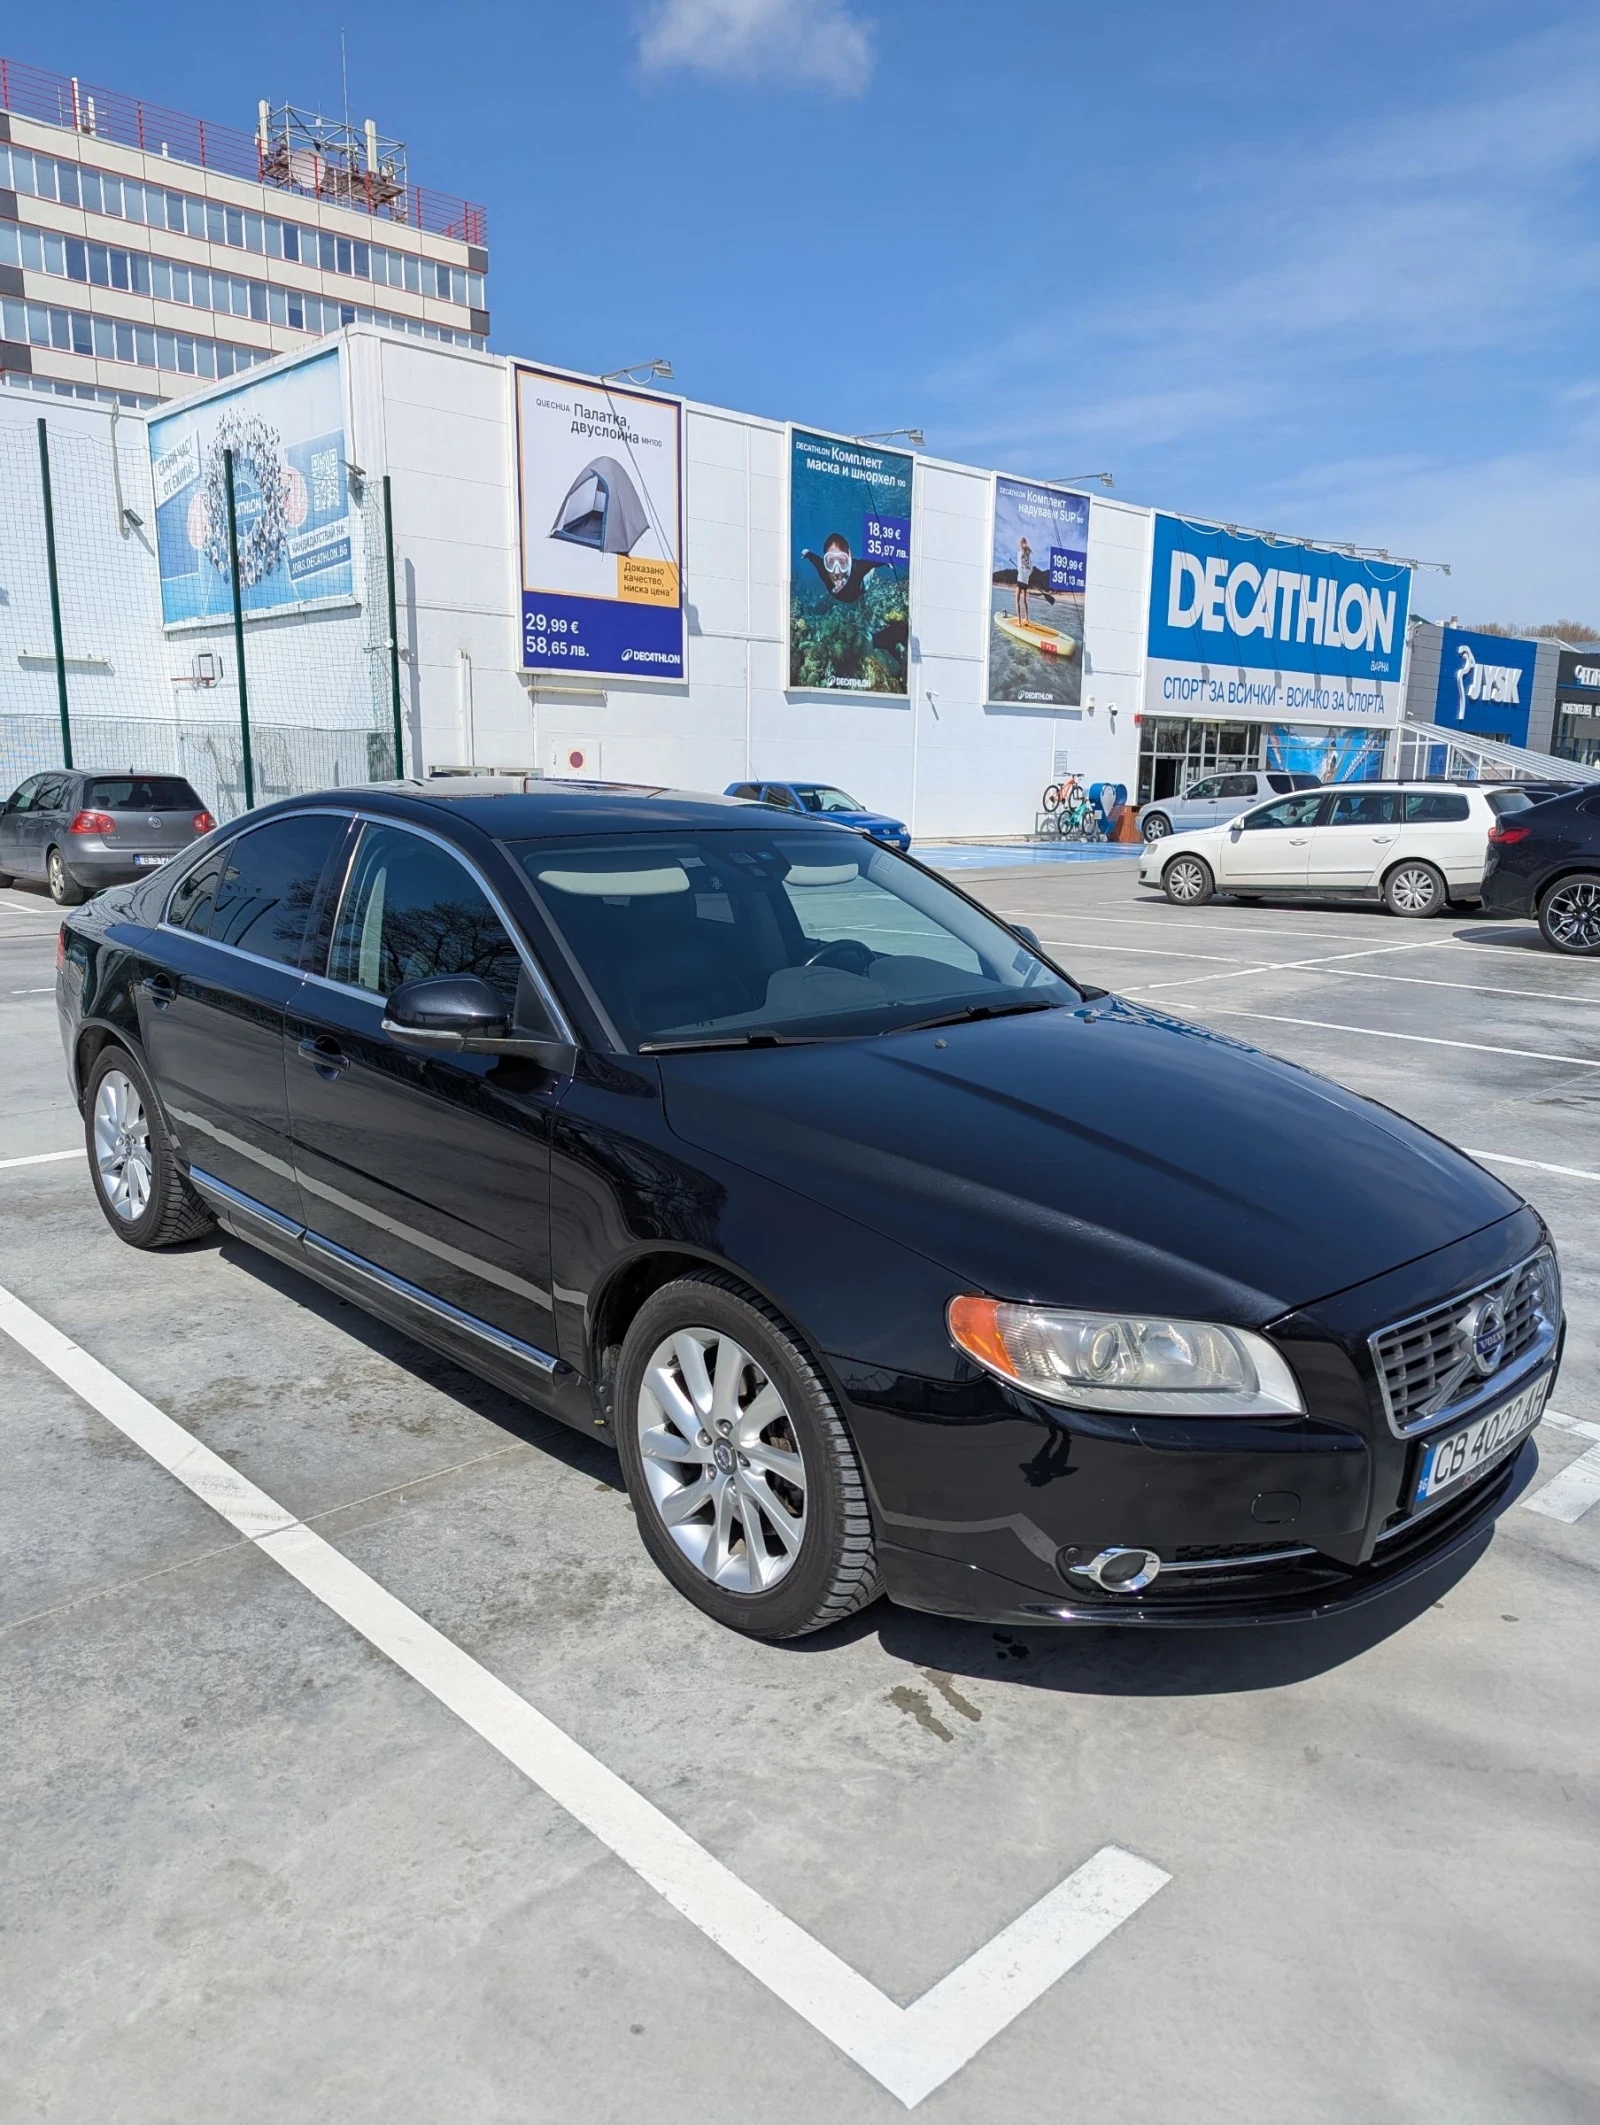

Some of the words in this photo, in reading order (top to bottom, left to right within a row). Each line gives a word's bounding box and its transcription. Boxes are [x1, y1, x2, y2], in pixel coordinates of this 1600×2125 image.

[536, 398, 570, 412] QUECHUA
[574, 403, 630, 430] Палатка,
[571, 420, 639, 444] двуслойна
[796, 441, 830, 456] DECATHLON
[831, 447, 883, 470] Комплект
[806, 458, 839, 474] маска
[842, 467, 849, 477] и
[851, 468, 895, 487] шнорхел
[1027, 490, 1067, 509] Комплект
[1018, 503, 1059, 519] надуваем
[1060, 509, 1076, 523] SUP
[868, 521, 894, 540] 18,39
[895, 529, 901, 540] €
[291, 543, 348, 575] JOBS.DECATHLON.BG
[867, 539, 894, 557] 35,97
[896, 548, 909, 559] лв.
[624, 561, 665, 576] Доказано
[1052, 554, 1077, 571] 199,99
[1078, 562, 1084, 571] €
[623, 574, 664, 587] качество,
[1052, 571, 1076, 586] 391,13
[623, 585, 649, 595] ниска
[1167, 549, 1396, 654] DECATHLON
[525, 612, 567, 634] 29,99
[570, 621, 579, 634] €
[526, 635, 568, 657] 58,65
[570, 645, 590, 657] лв.
[633, 650, 681, 664] DECATHLON
[1370, 660, 1389, 673] ВАРНА
[836, 677, 872, 688] DECATHLON
[1467, 663, 1523, 704] JYSK
[1024, 691, 1054, 701] DECATHLON
[1163, 676, 1207, 700] СПОРТ
[1208, 681, 1224, 701] ЗА
[1228, 682, 1276, 705] ВСИЧКИ
[1286, 686, 1330, 710] ВСИЧКО
[1331, 691, 1345, 711] ЗА
[1347, 691, 1385, 714] СПОРТА
[1434, 1431, 1469, 1485] CB
[1470, 1397, 1523, 1462] 4022
[1518, 1374, 1550, 1430] AH
